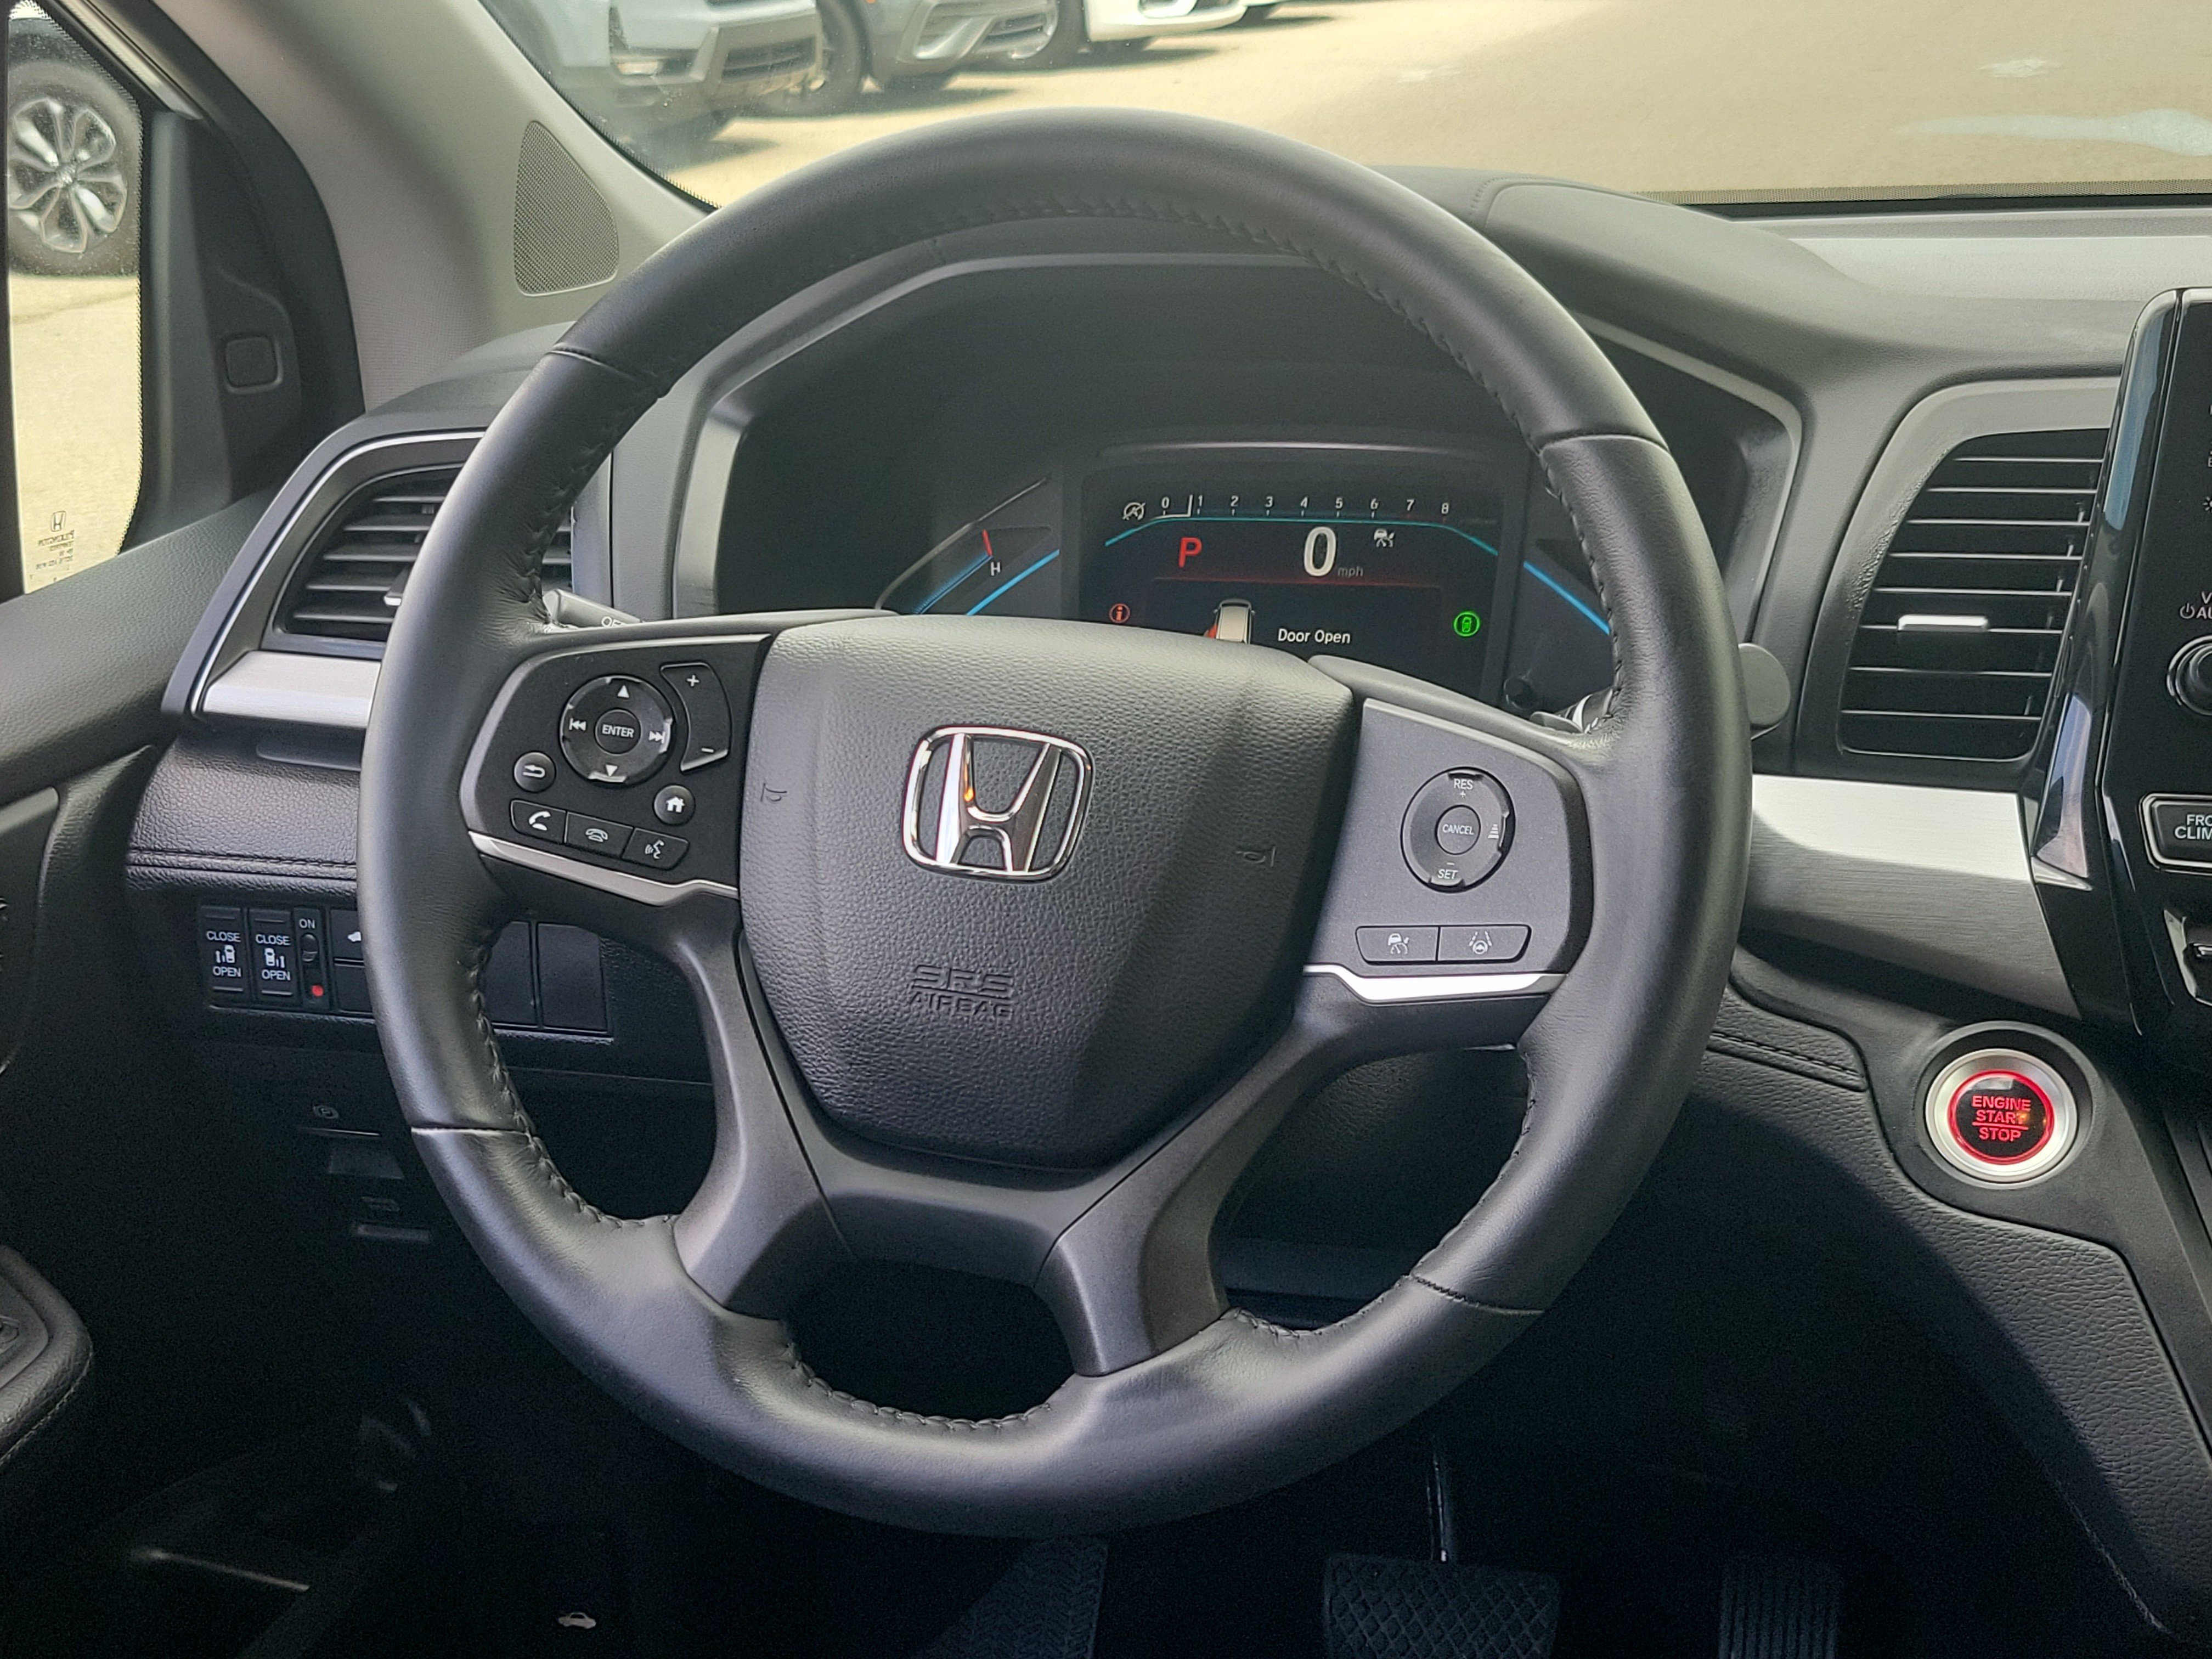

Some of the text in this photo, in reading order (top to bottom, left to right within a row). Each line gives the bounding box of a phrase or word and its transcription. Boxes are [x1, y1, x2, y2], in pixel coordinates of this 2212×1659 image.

[1161, 494, 1449, 515] 0 1 2 3 4 5 6 7 8
[1178, 537, 1202, 567] P
[1304, 526, 1363, 577] 0 mph
[990, 562, 1000, 575] H
[1278, 628, 1351, 644] Door Open
[602, 725, 634, 738] ENTER
[1453, 778, 1473, 789] RES
[1442, 824, 1474, 835] CANCEL
[1437, 869, 1459, 879] SET
[299, 919, 316, 929] ON
[206, 931, 241, 942] CLOSE
[255, 934, 291, 946] CLOSE
[212, 966, 241, 978] OPEN
[261, 969, 291, 981] OPEN
[913, 964, 1014, 1000] SRS
[1972, 1095, 2032, 1111] ENGINE
[1976, 1110, 2026, 1124] START
[1979, 1127, 2022, 1142] STOP
